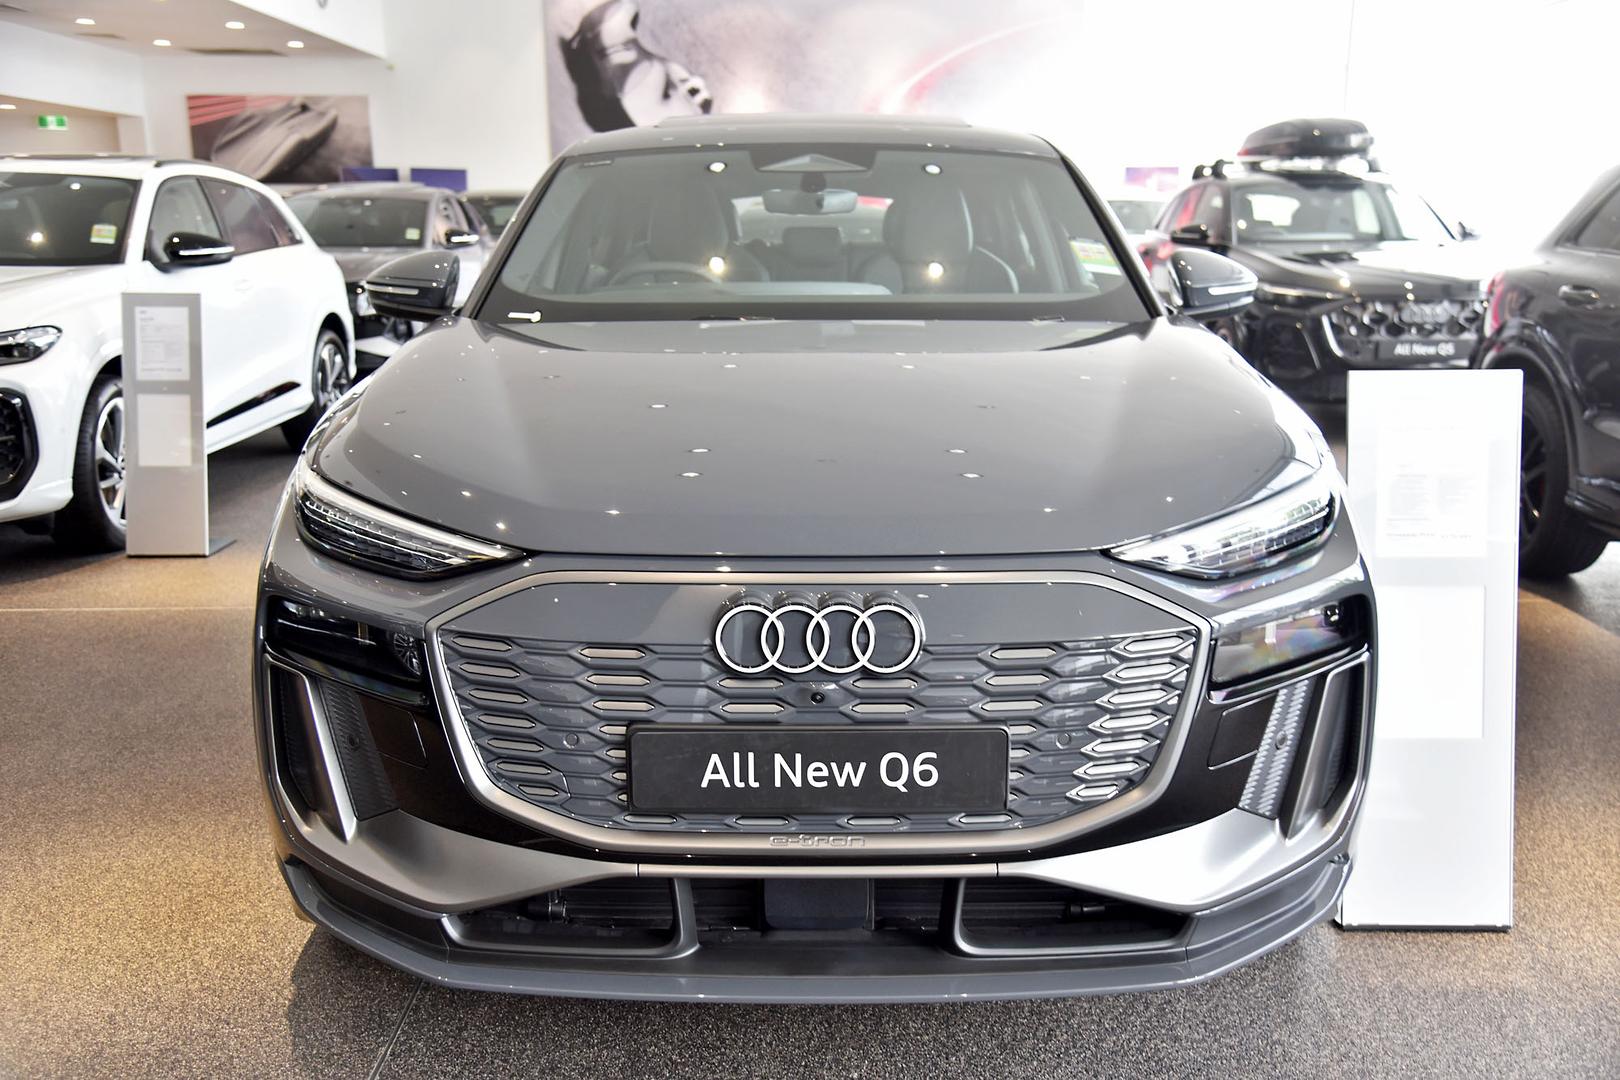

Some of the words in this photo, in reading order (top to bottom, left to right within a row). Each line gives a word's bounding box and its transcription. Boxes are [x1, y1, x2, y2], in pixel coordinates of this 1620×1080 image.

[1393, 343, 1411, 356] All
[1412, 343, 1437, 356] New
[700, 752, 760, 788] All
[774, 752, 867, 788] New
[879, 752, 939, 792] Q6
[769, 834, 866, 847] e-tron
